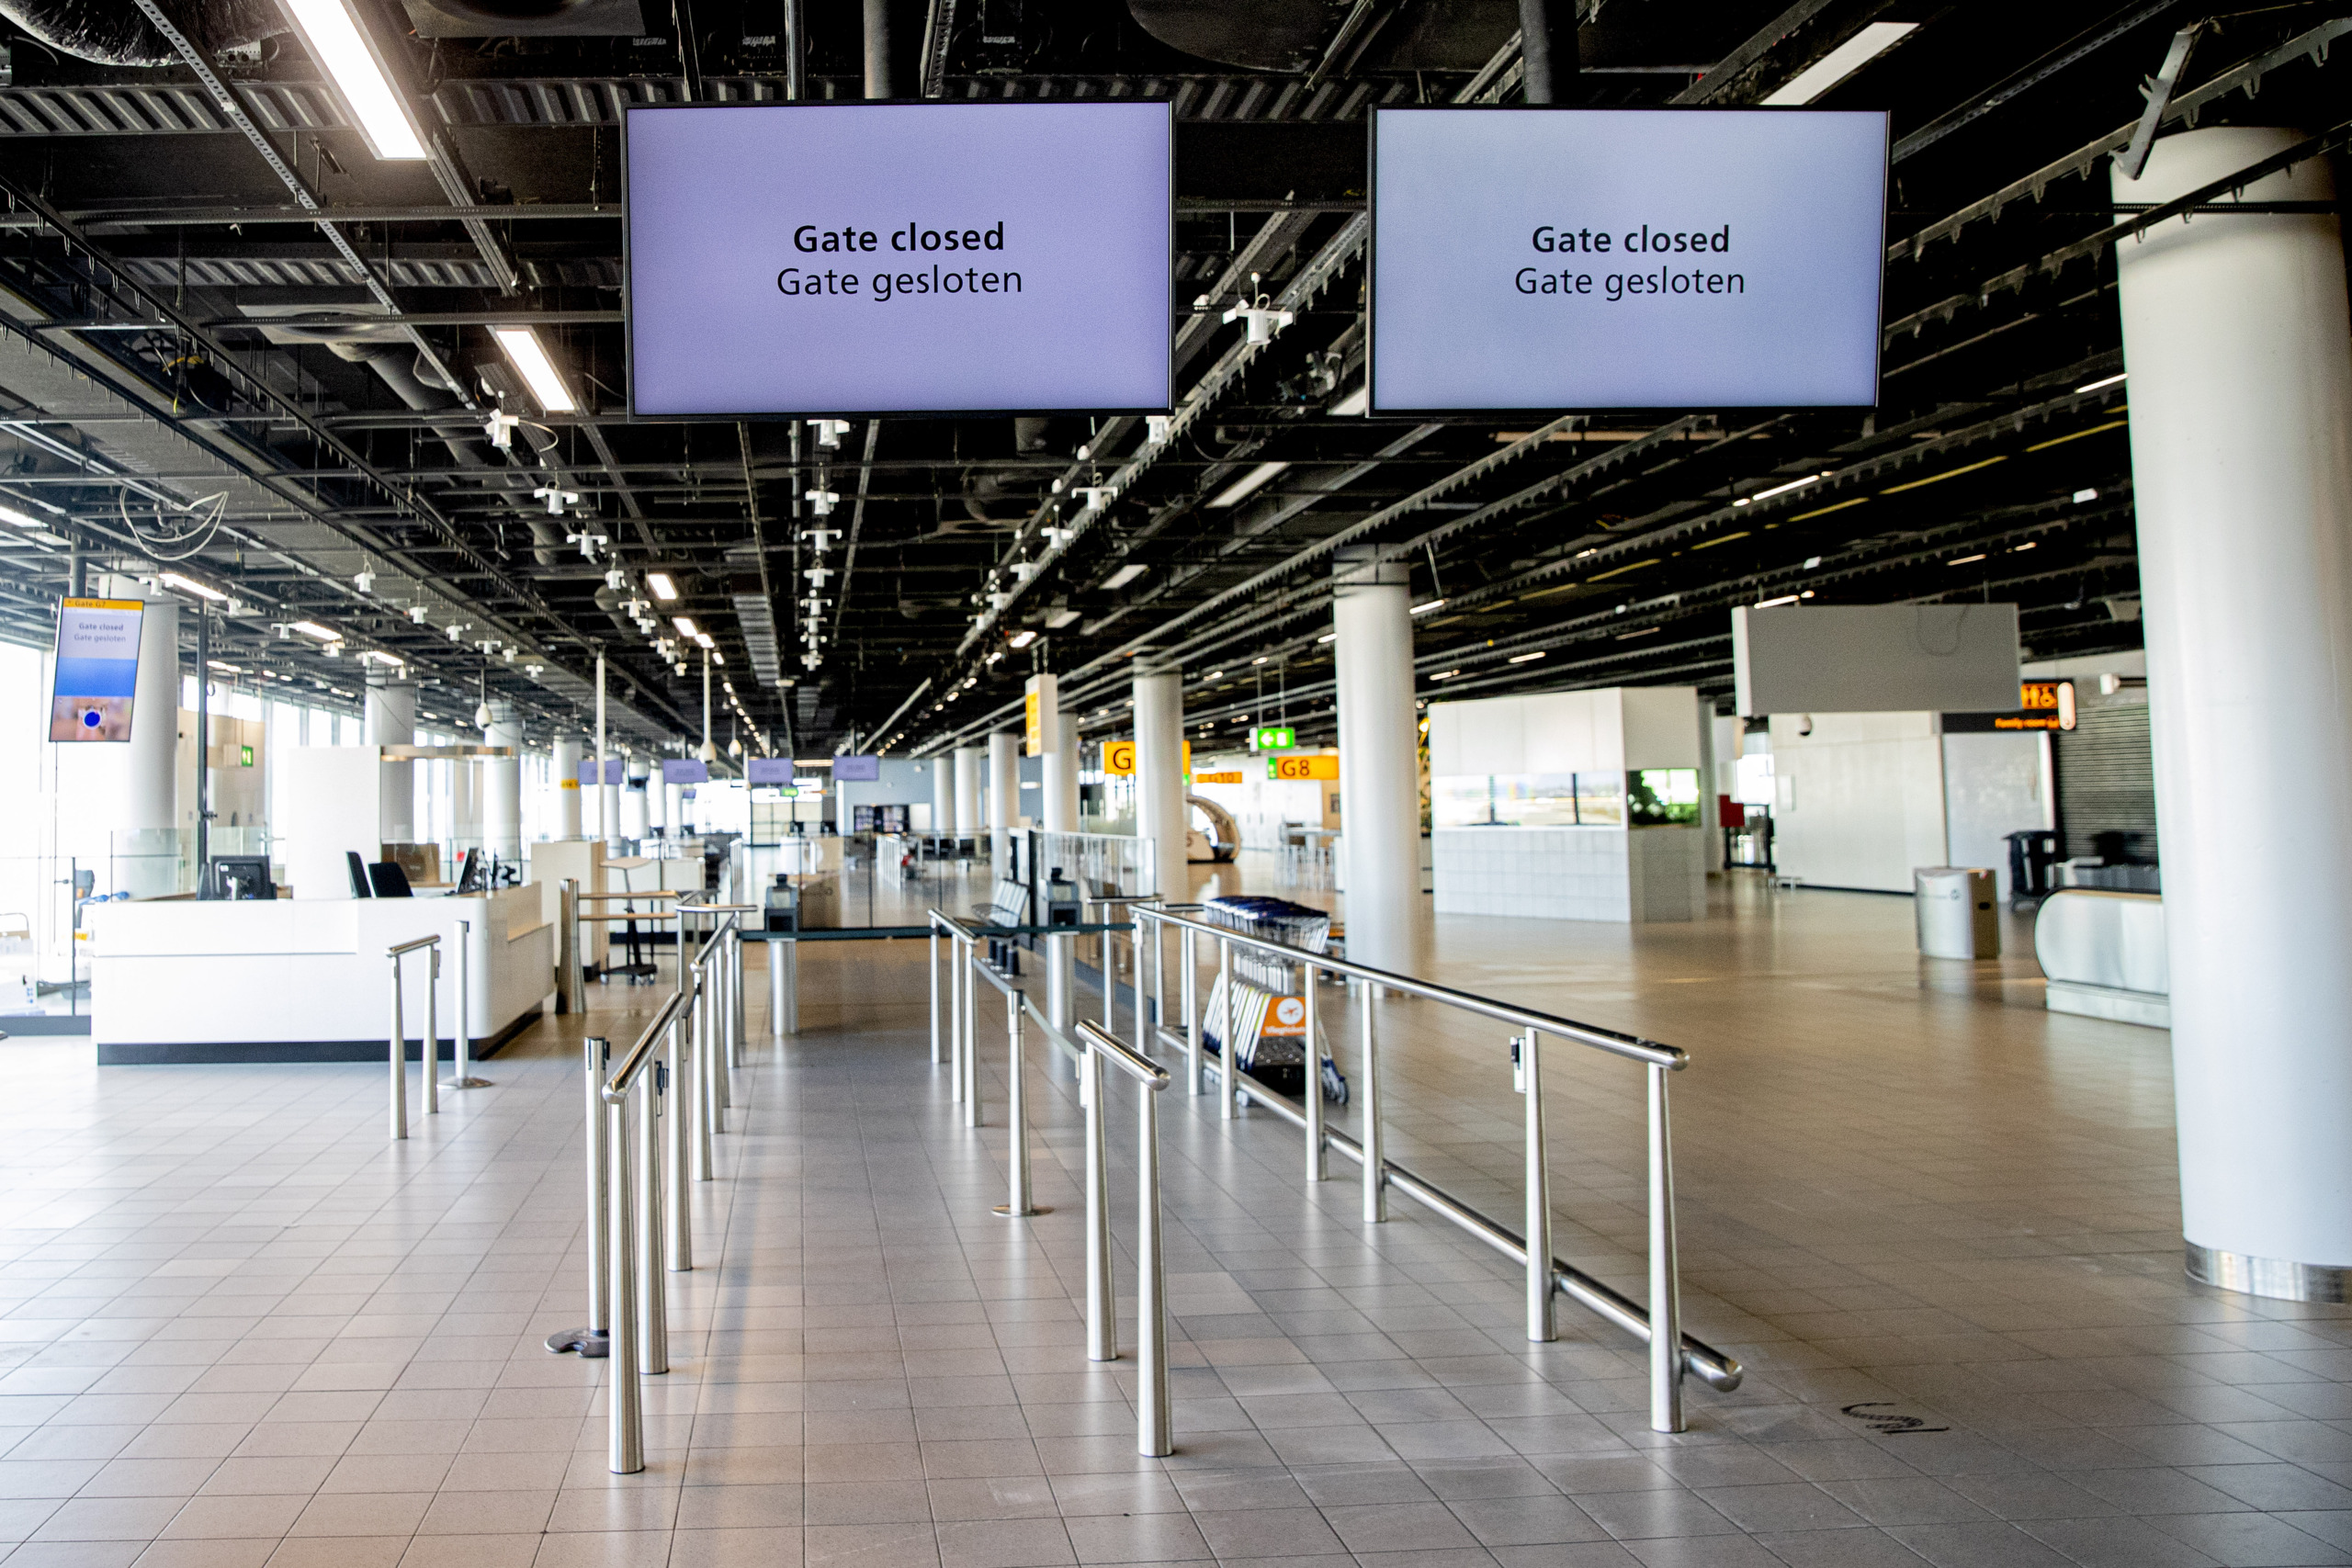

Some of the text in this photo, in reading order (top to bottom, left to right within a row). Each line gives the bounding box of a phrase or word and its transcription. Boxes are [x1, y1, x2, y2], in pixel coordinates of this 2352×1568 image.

[793, 220, 1004, 253] Gate closed
[1532, 224, 1730, 253] Gate closed
[776, 264, 1023, 302] Gate gesloten
[1515, 265, 1745, 302] Gate gesloten
[79, 622, 124, 631] Gate closed
[94, 634, 127, 643] gesloten
[1113, 748, 1132, 770] G
[1282, 759, 1310, 777] G8
